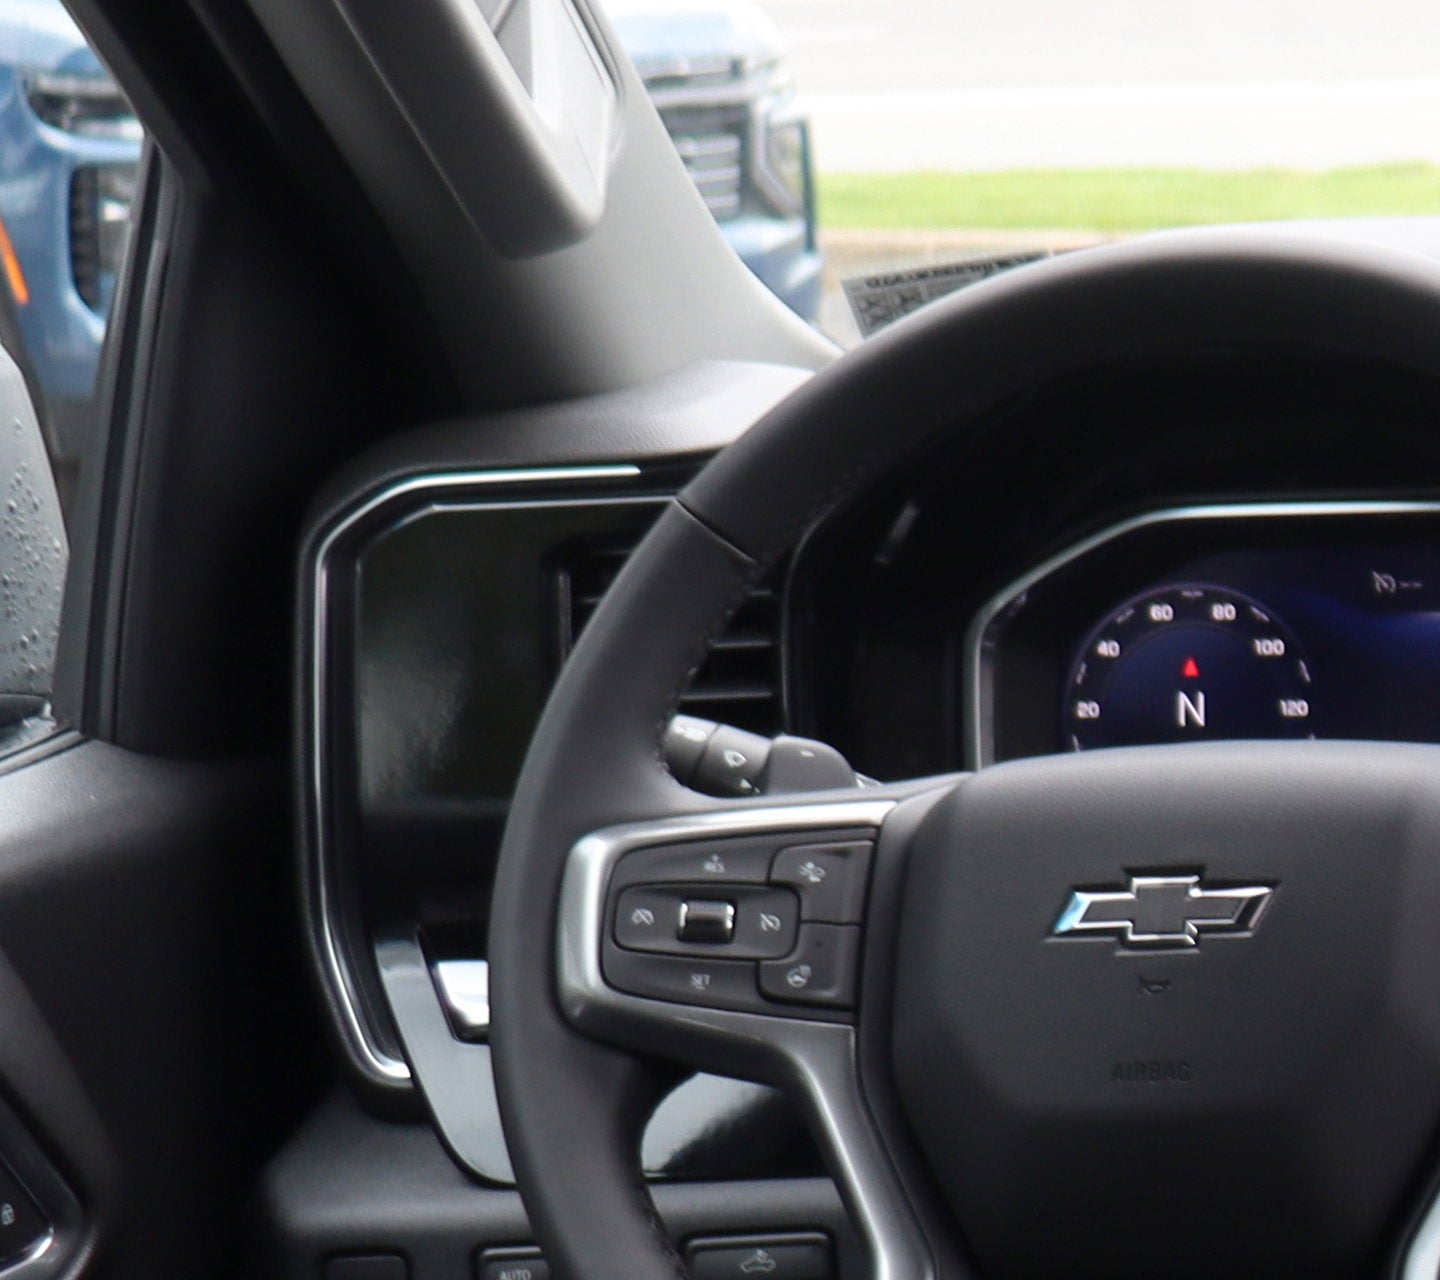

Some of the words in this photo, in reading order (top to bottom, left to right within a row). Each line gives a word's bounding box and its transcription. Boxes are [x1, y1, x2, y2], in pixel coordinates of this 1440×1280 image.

[1151, 604, 1174, 621] 60
[1212, 604, 1236, 621] 80
[1098, 640, 1121, 658] 40
[1254, 639, 1286, 656] 100
[1077, 701, 1100, 718] 20
[1175, 690, 1206, 727] N
[1279, 700, 1309, 717] 120
